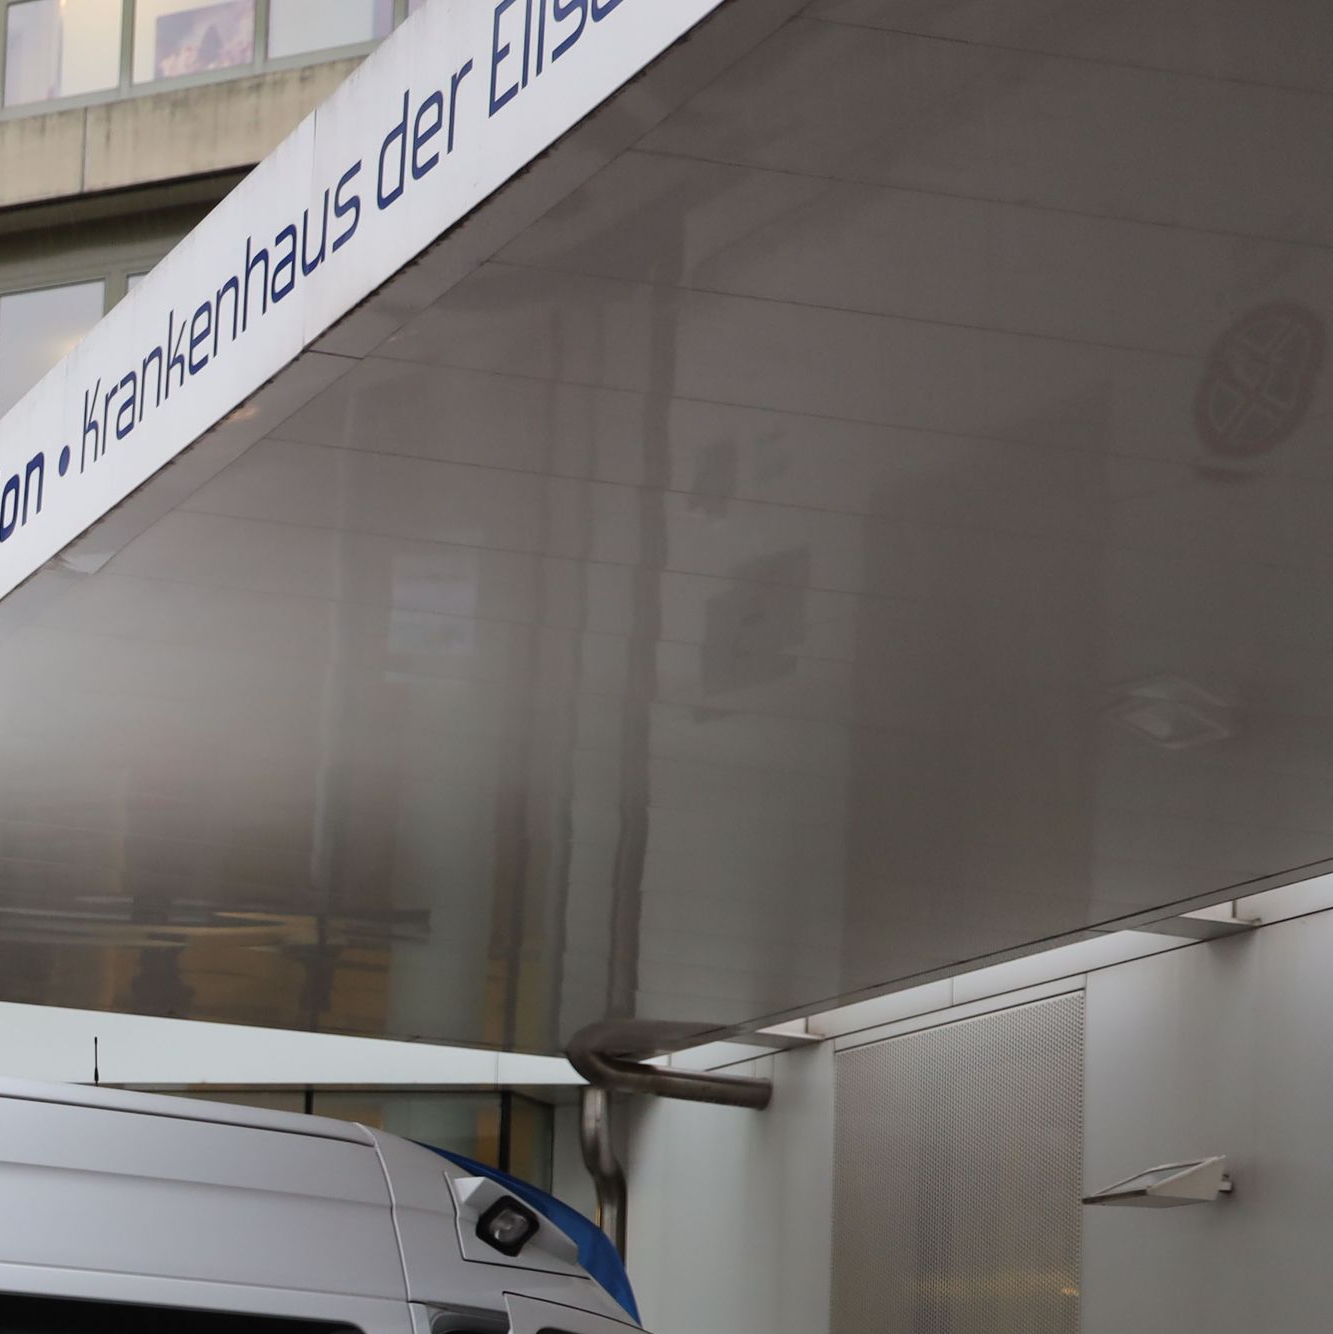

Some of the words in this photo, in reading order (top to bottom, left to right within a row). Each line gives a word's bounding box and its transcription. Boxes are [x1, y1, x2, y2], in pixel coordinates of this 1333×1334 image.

[79, 160, 363, 475] Krankenhaus
[377, 57, 474, 212] der
[488, 0, 625, 119] Elis
